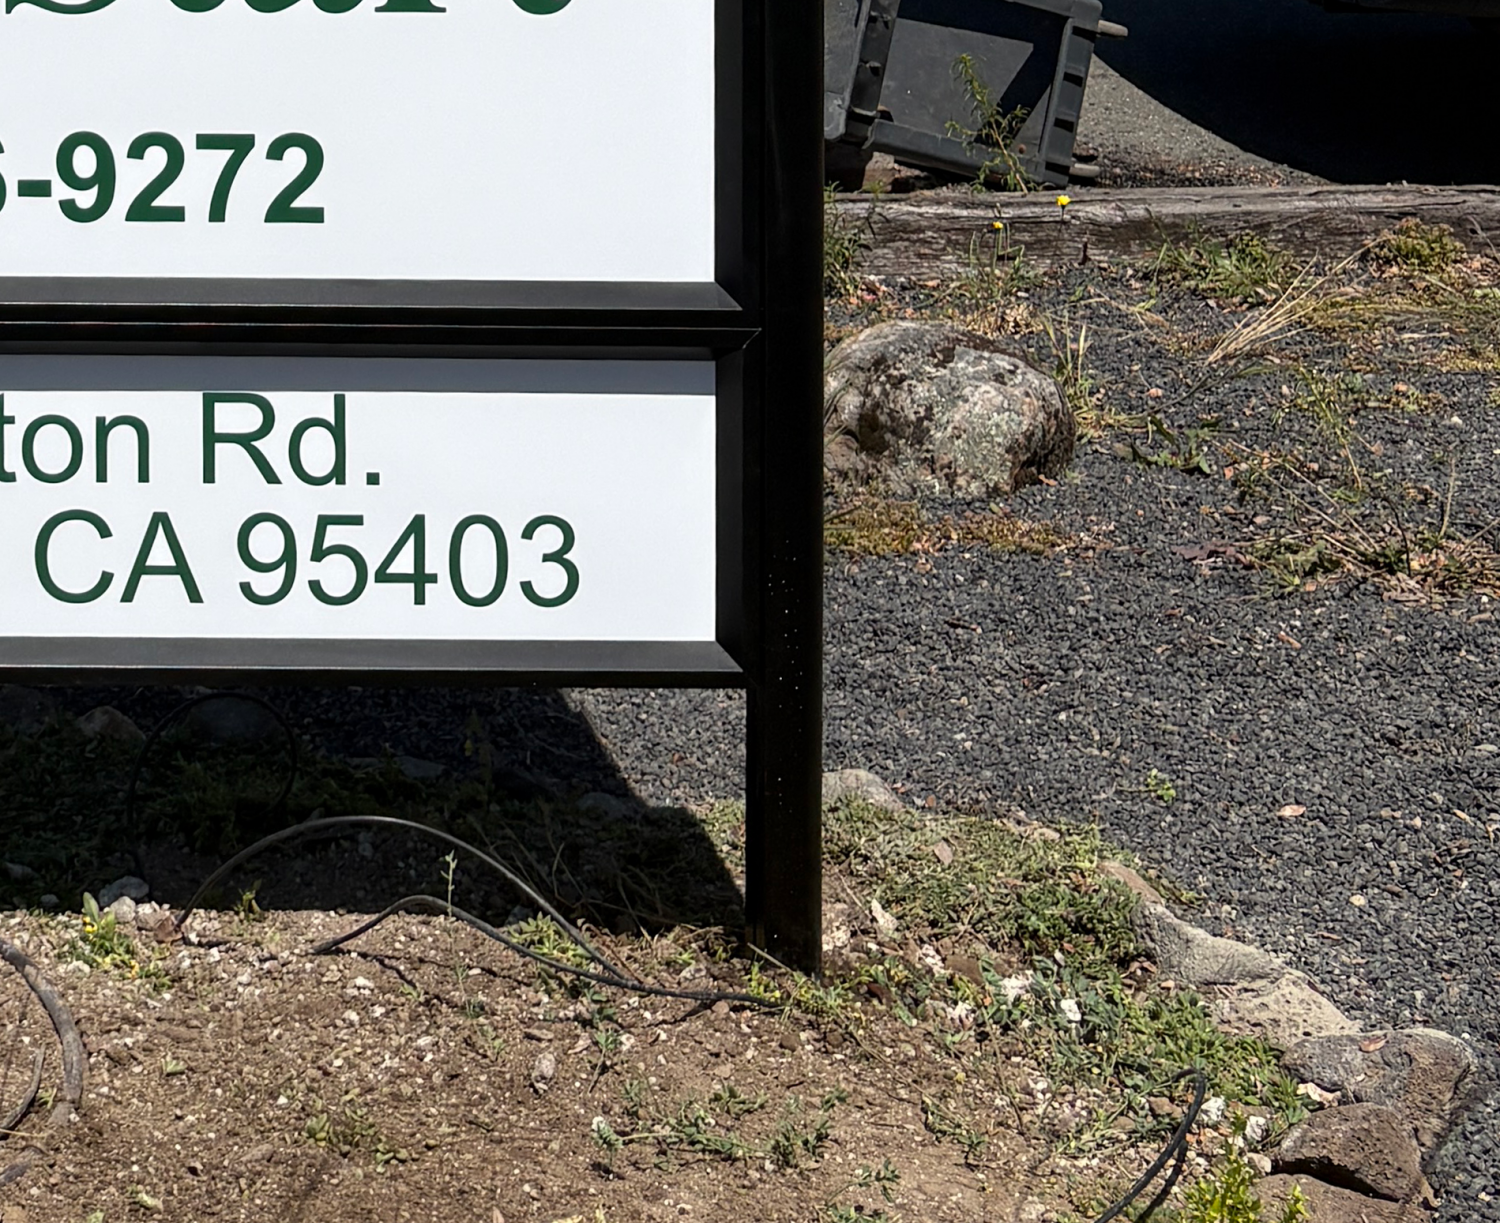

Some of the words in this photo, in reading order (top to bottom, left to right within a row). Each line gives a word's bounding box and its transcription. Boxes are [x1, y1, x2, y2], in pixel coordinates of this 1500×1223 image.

[202, 392, 380, 486] Rd.
[35, 509, 204, 603] CA
[237, 512, 580, 607] 95403
